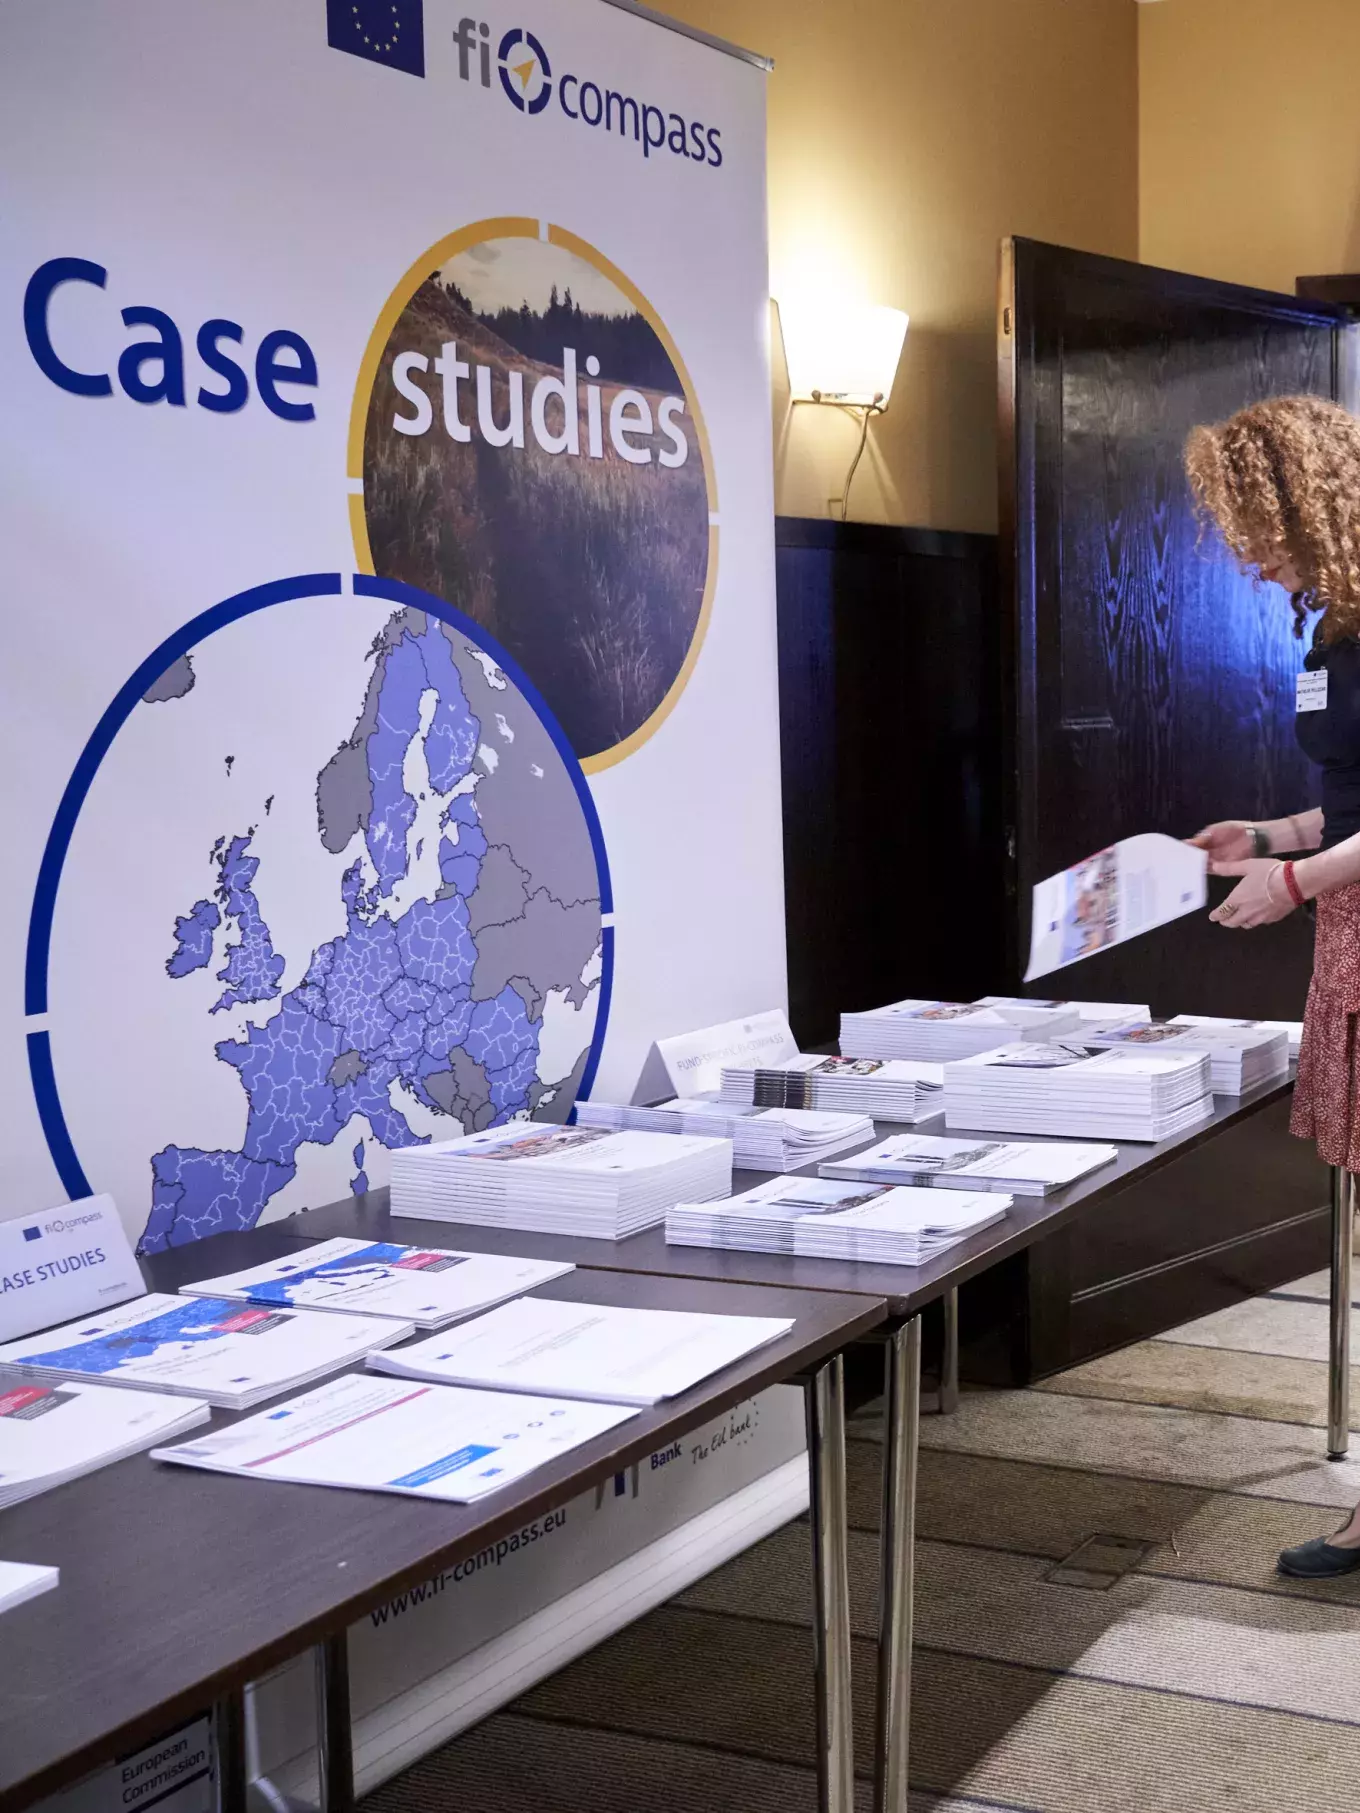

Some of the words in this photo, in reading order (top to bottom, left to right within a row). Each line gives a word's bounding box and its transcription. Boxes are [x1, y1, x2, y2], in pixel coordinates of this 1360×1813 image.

[453, 17, 491, 88] fi
[558, 74, 723, 168] compass
[23, 256, 319, 423] Case
[391, 340, 690, 469] studies
[64, 1211, 103, 1228] compass
[36, 1248, 106, 1281] STUDIES
[650, 1441, 683, 1471] Bank
[690, 1444, 709, 1465] The
[729, 1412, 751, 1441] bank
[370, 1508, 567, 1628] www.fi-compass.eu
[122, 1739, 188, 1783] European
[122, 1750, 205, 1804] Commission
